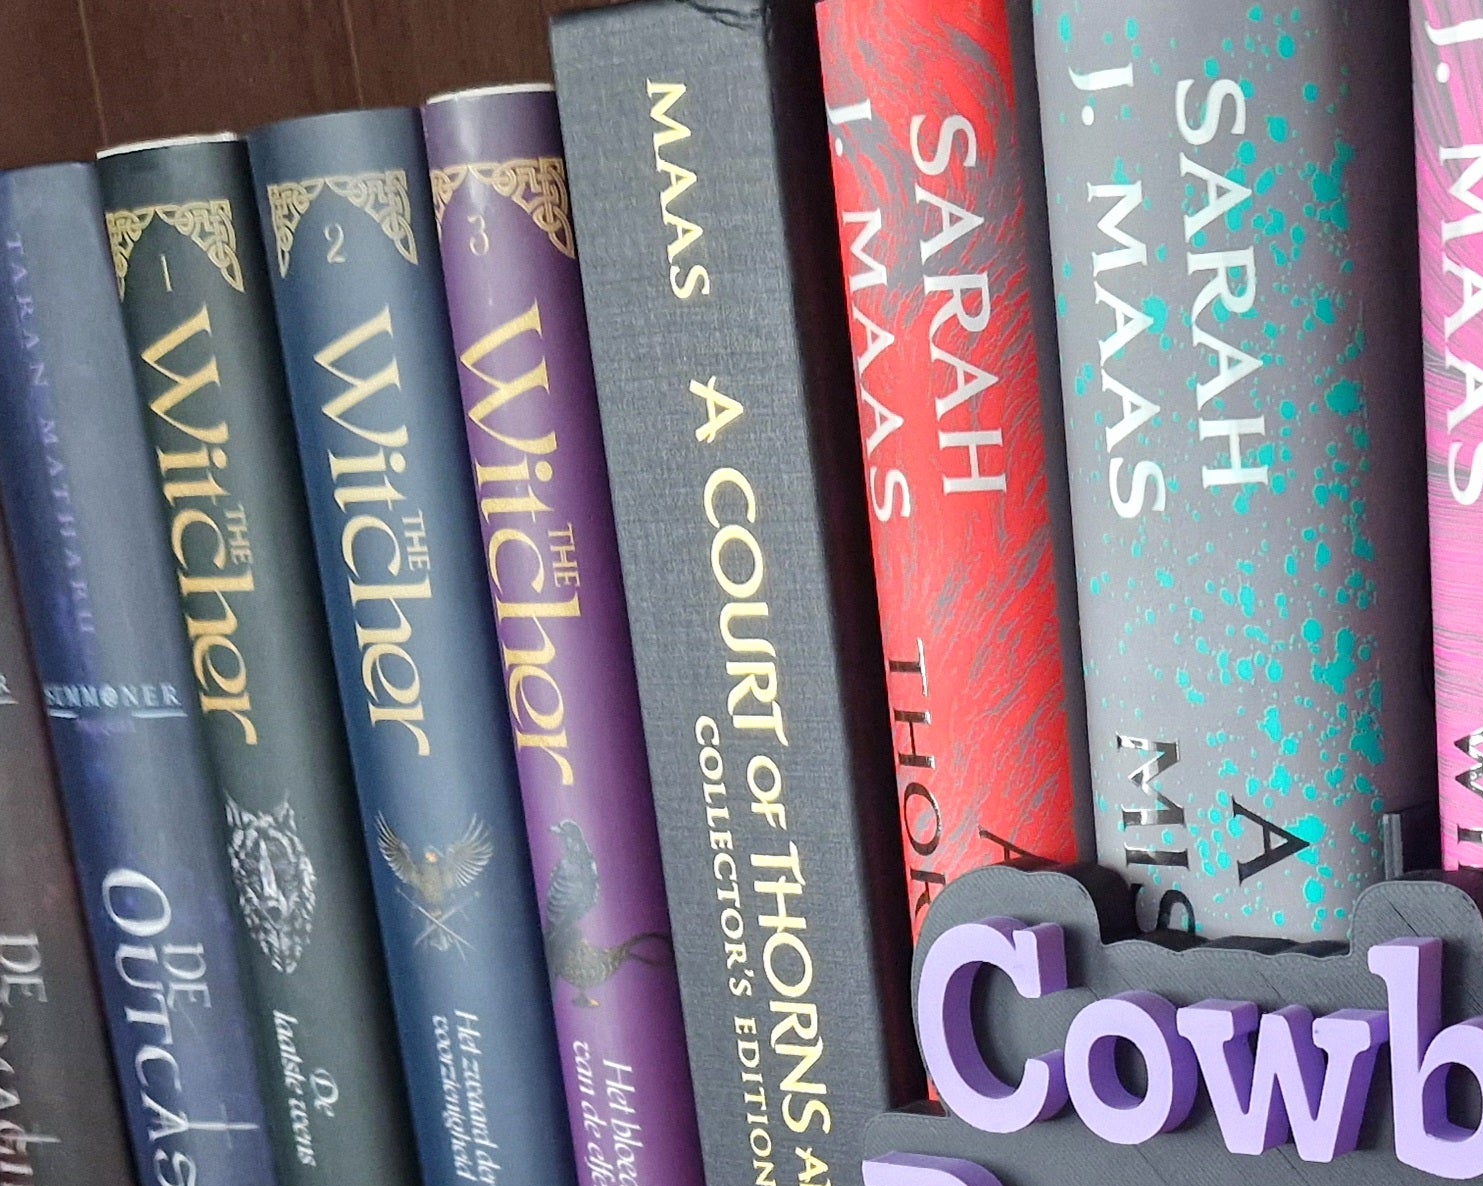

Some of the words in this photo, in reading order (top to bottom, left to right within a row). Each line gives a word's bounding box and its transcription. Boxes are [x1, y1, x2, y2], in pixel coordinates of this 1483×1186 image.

[1068, 62, 1134, 127] J.
[646, 78, 712, 300] MAAS
[323, 223, 348, 264] 2
[467, 214, 491, 258] 3
[910, 114, 1007, 495] SARAH
[1175, 79, 1269, 490] SARAH
[842, 209, 911, 522] MAAS
[1087, 180, 1166, 519] MAAS
[6, 236, 48, 387] TARAN
[38, 418, 94, 634] MATHARU
[689, 375, 744, 444] A
[140, 305, 257, 745] Witcher
[225, 505, 250, 564] THE
[313, 304, 433, 756] Witcher
[406, 510, 430, 570] THE
[460, 302, 580, 785] Witcher
[549, 523, 579, 587] THE
[703, 468, 790, 747] COURT
[746, 757, 788, 833] OF
[1115, 732, 1196, 935] MIS
[692, 715, 755, 998] COLLECTOR'S
[1231, 798, 1310, 887] A
[164, 942, 212, 1010] DE
[750, 842, 832, 1135] THORNS
[309, 1068, 339, 1118] De
[573, 1040, 596, 1097] van
[603, 1058, 637, 1115] Het
[582, 1100, 607, 1139] de
